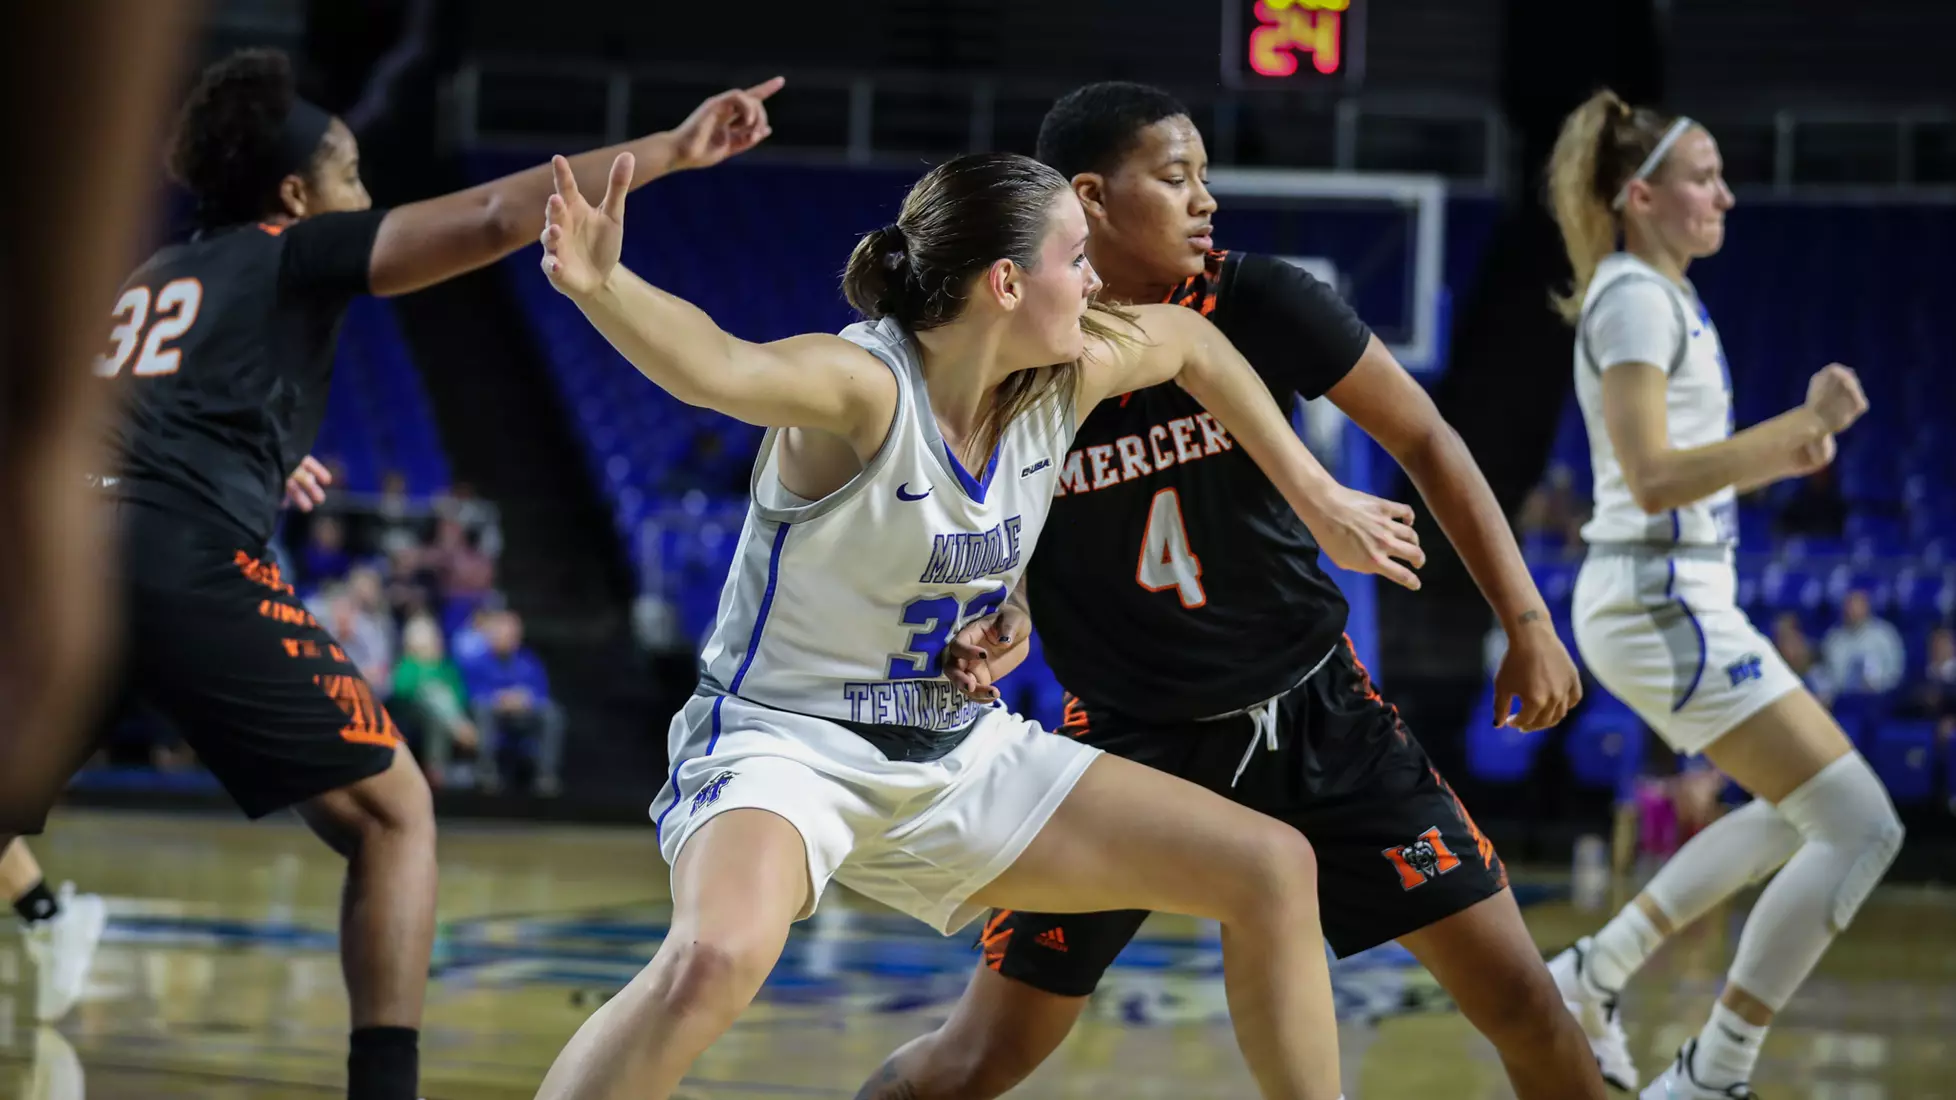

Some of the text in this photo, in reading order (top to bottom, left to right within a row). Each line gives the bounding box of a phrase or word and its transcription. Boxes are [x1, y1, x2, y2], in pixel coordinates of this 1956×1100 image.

[1249, 2, 1341, 77] 24
[91, 276, 203, 379] 32
[1052, 411, 1233, 498] MERCER
[919, 515, 1022, 583] MIDDLE
[1135, 486, 1207, 609] 4
